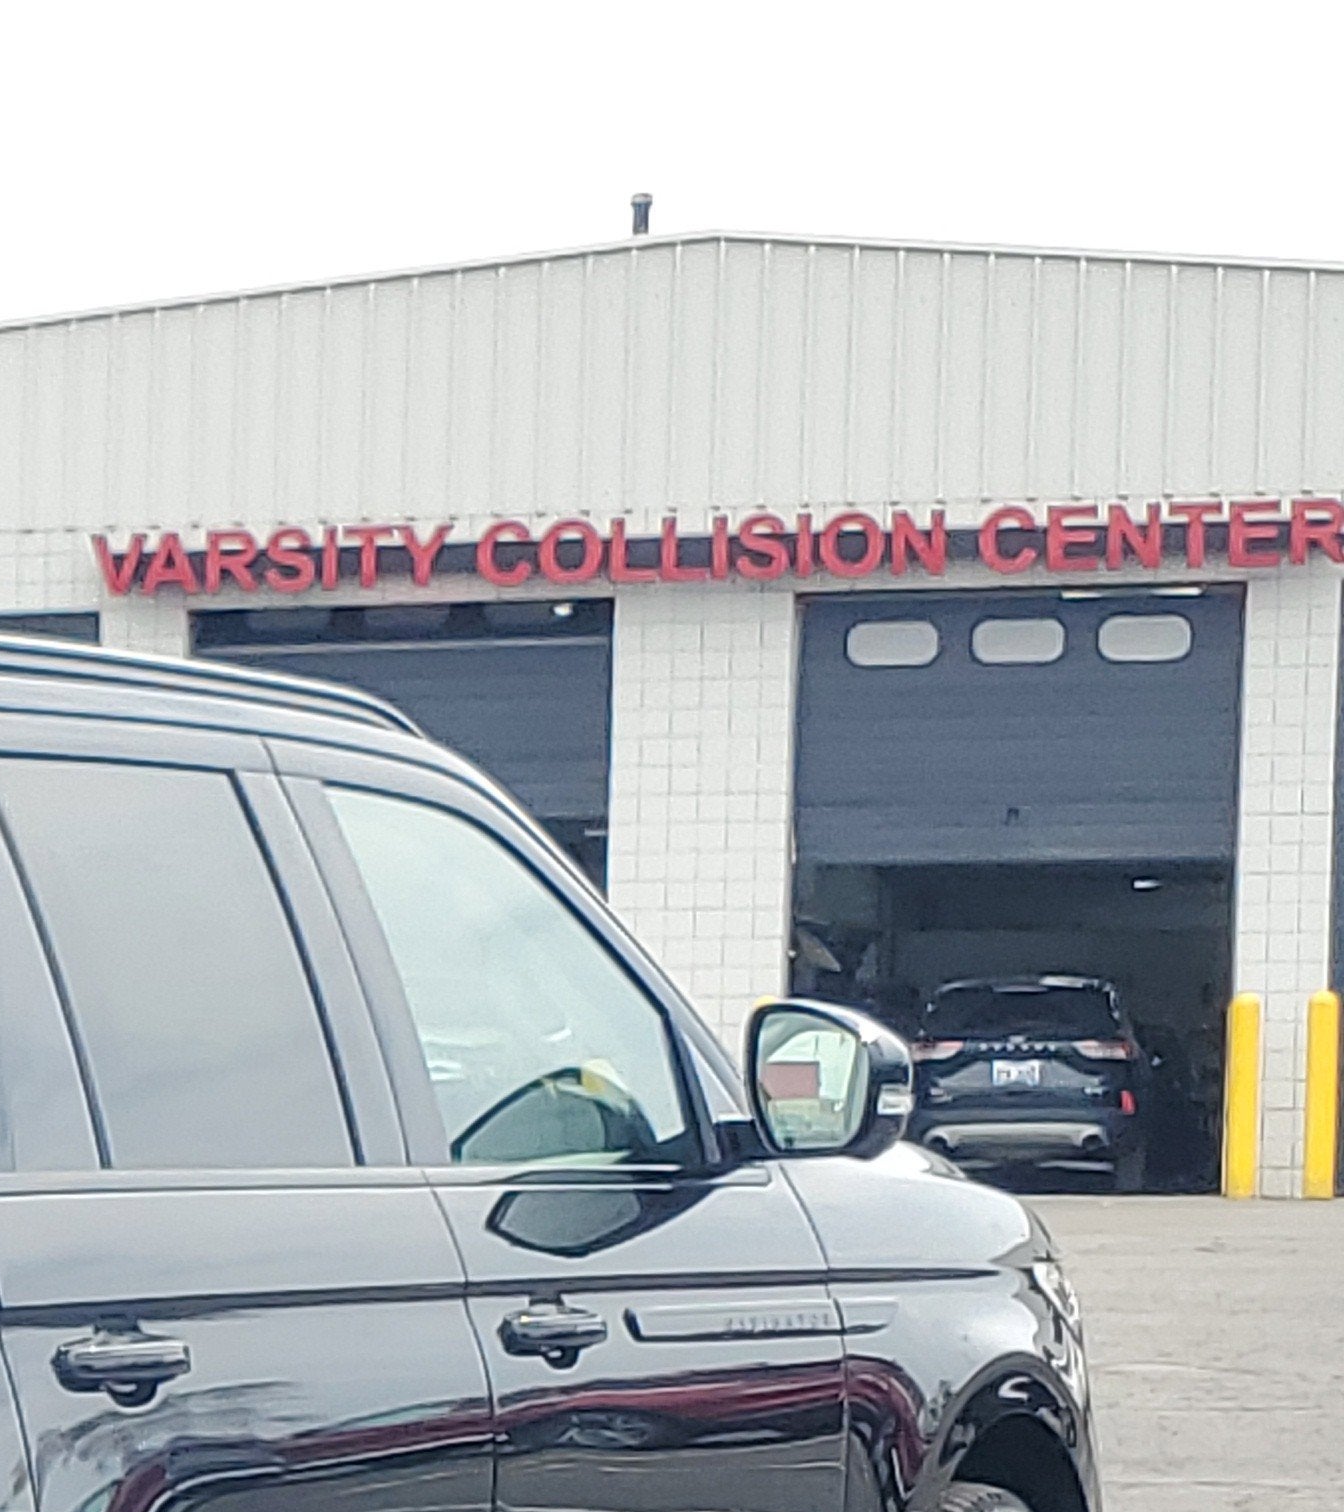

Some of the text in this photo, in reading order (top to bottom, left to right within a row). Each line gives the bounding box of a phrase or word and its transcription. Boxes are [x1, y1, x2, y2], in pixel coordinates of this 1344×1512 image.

[90, 498, 1344, 597] VARSITY COLLISION CENTER
